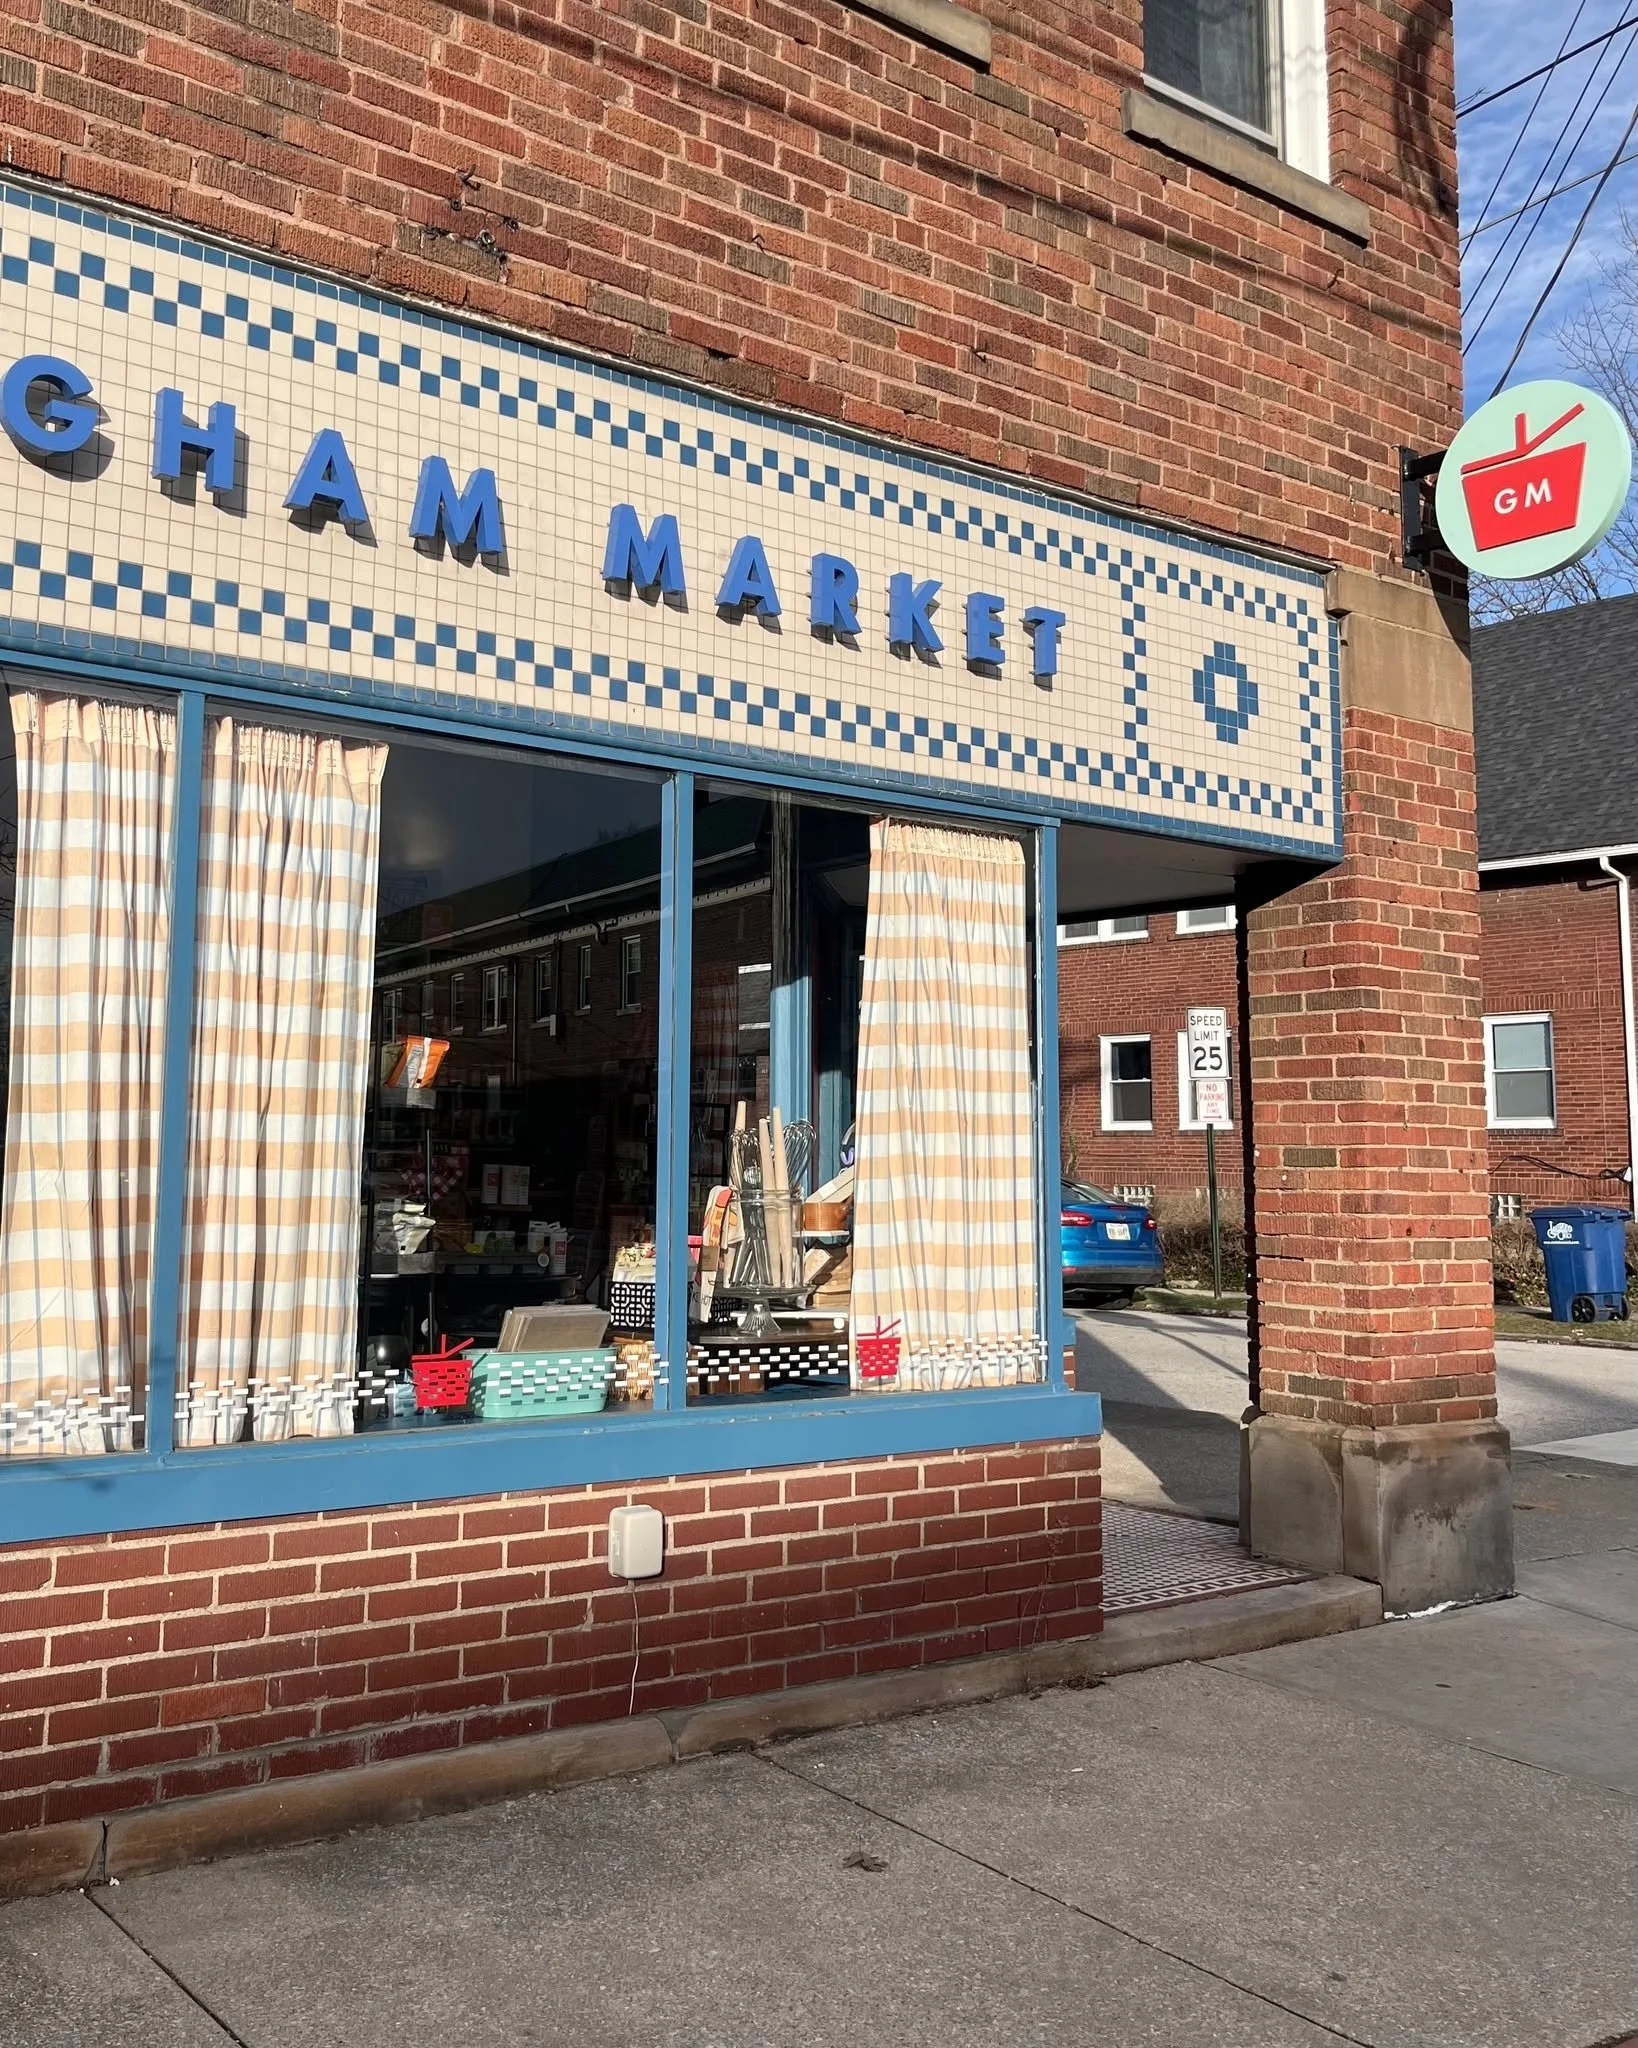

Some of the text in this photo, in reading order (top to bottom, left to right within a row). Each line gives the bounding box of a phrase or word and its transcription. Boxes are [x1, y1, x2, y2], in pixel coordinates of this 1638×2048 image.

[1494, 478, 1552, 515] GM
[0, 354, 1066, 677] GHAM MARKET
[1190, 1015, 1222, 1026] SPEED
[1194, 1030, 1219, 1041] LIMIT
[1193, 1046, 1222, 1071] 25
[1206, 1083, 1218, 1092] NO
[1200, 1093, 1225, 1102] PARKING
